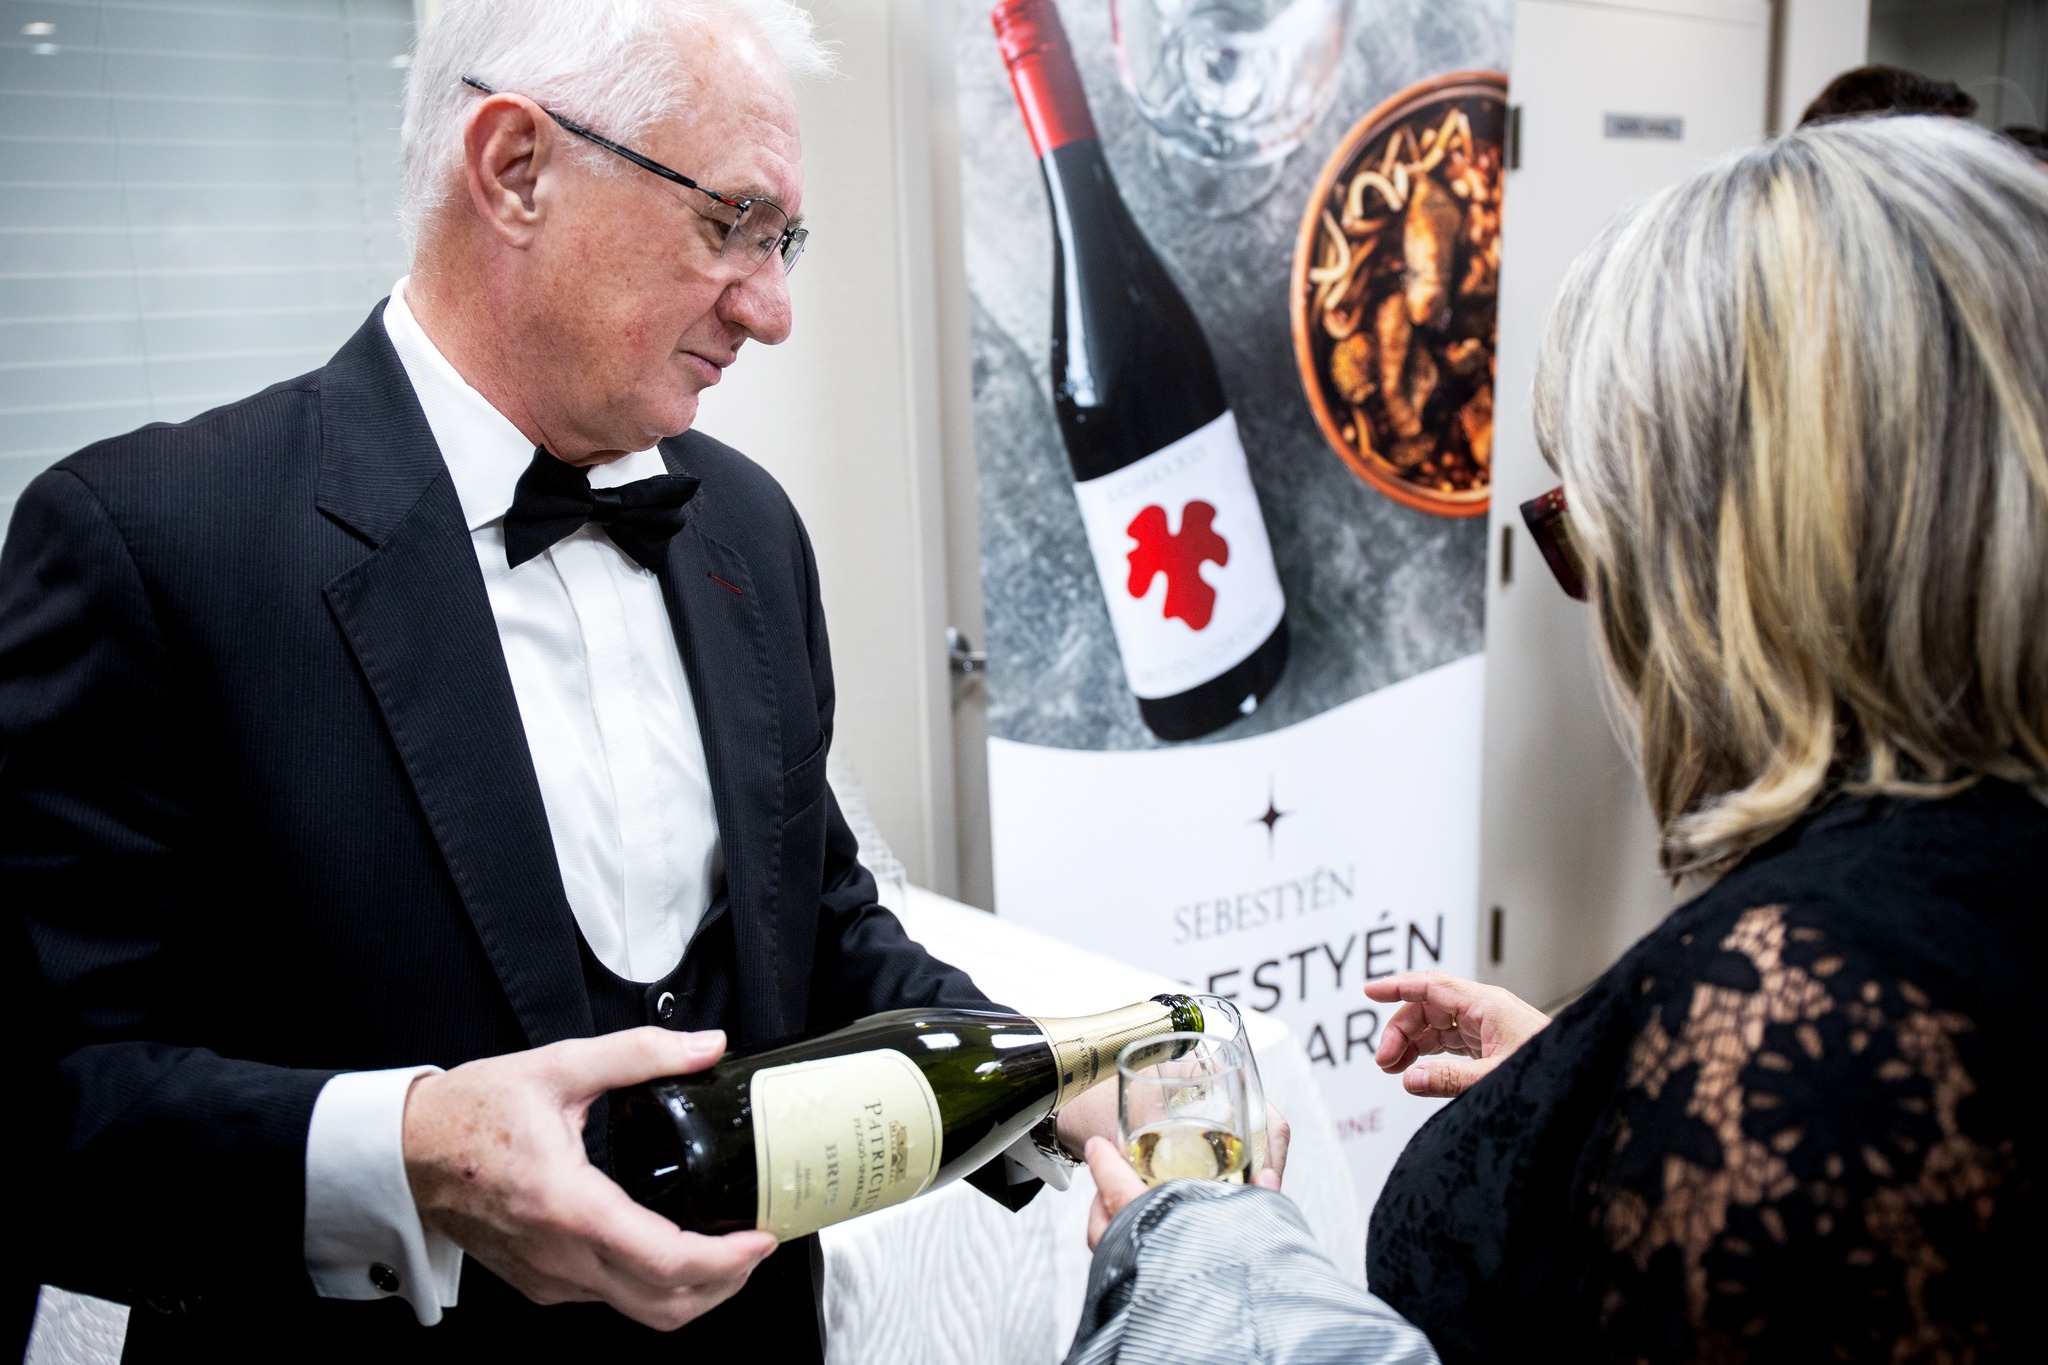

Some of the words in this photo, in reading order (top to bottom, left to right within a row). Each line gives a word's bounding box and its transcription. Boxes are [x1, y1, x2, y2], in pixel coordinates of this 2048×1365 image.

[1173, 864, 1355, 944] SEBESTYÉN
[1176, 911, 1443, 1012] ESTYÉN
[824, 1142, 839, 1205] BRUT
